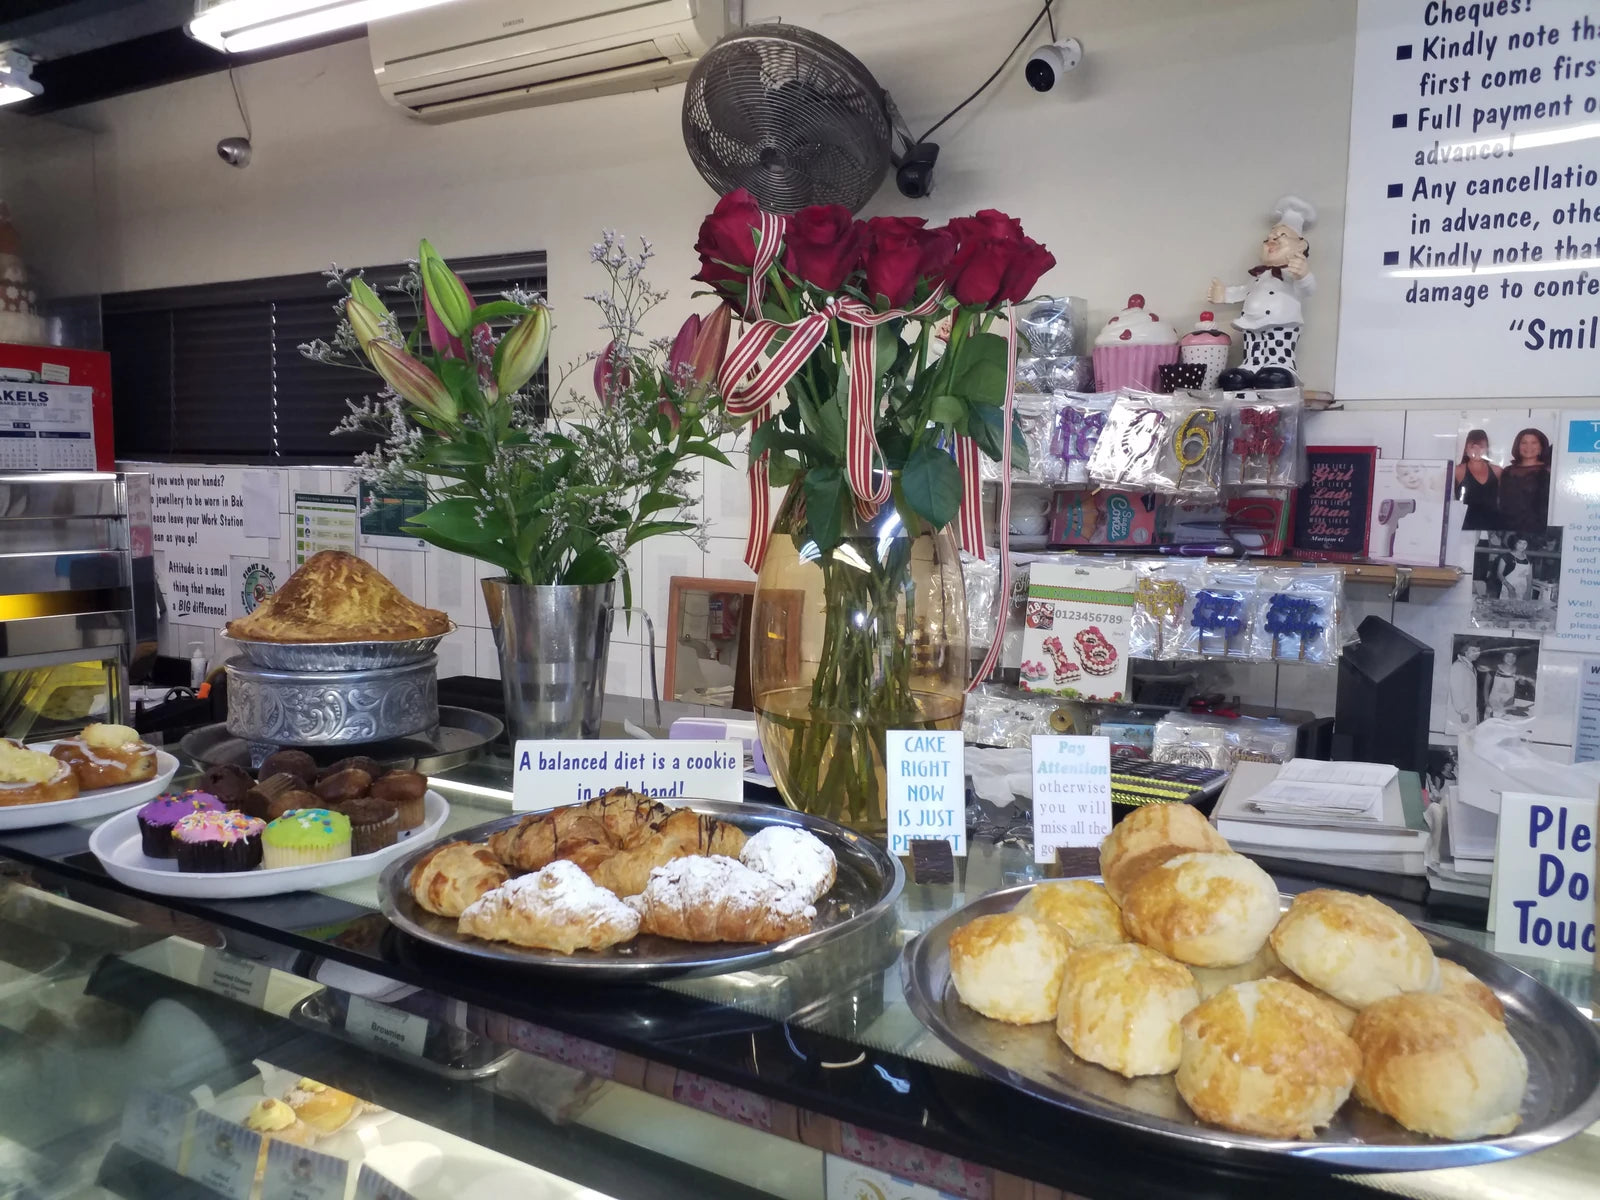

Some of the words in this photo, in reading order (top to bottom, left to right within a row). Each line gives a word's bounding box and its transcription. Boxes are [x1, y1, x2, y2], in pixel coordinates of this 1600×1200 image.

[1423, 30, 1498, 61] Kindly
[1508, 25, 1559, 50] note
[1572, 15, 1600, 42] th
[1420, 71, 1471, 96] first
[1482, 67, 1541, 89] come
[1554, 55, 1600, 80] firs
[1418, 103, 1461, 131] Full
[1473, 94, 1573, 133] payment
[1584, 97, 1600, 113] o
[1415, 132, 1515, 166] advance!
[1412, 176, 1456, 205] Any
[1466, 164, 1598, 196] cancellatio
[1411, 213, 1430, 235] in
[1441, 207, 1541, 233] advance,
[1553, 199, 1600, 225] othe
[1409, 242, 1483, 273] Kindly
[1493, 241, 1543, 264] note
[1406, 280, 1489, 308] damage
[1500, 278, 1523, 299] to
[1534, 271, 1600, 297] confe
[148, 473, 155, 485] d
[157, 477, 168, 488] you
[169, 474, 184, 486] wash
[186, 477, 200, 490] your
[202, 474, 225, 487] hands?
[156, 493, 184, 509] jewellery
[186, 495, 193, 506] to
[195, 494, 202, 506] be
[204, 498, 220, 507] worn
[222, 496, 229, 507] in
[231, 495, 244, 507] Bak
[153, 514, 166, 523] ease
[168, 512, 184, 524] leave
[186, 516, 200, 528] your
[201, 513, 218, 526] Work
[219, 514, 244, 527] Station
[154, 534, 164, 542] ean
[166, 534, 173, 542] as
[175, 535, 185, 546] you
[188, 532, 198, 547] go!
[168, 561, 195, 574] Attitude
[196, 564, 203, 574] is
[205, 566, 209, 575] a
[210, 564, 228, 577] small
[173, 580, 189, 596] thing
[191, 581, 204, 594] that
[206, 583, 225, 597] makes
[172, 602, 176, 611] a
[178, 600, 191, 613] BIG
[192, 601, 227, 616] difference!
[1055, 610, 1122, 624] 0123456789
[904, 736, 946, 752] CAKE
[1058, 741, 1086, 756] Pay
[519, 751, 531, 771] A
[538, 751, 607, 770] balanced
[614, 750, 645, 769] diet
[652, 752, 665, 769] is
[672, 756, 680, 769] a
[686, 750, 736, 769] cookie
[901, 760, 950, 777] RIGHT
[1037, 761, 1107, 775] Attention
[577, 783, 592, 800] in
[598, 781, 633, 798] eh
[641, 781, 684, 798] hand!
[907, 785, 944, 802] NOW
[1039, 780, 1106, 794] otherwise
[1039, 803, 1066, 816] you
[1078, 801, 1106, 814] will
[898, 809, 911, 827] IS
[916, 809, 955, 827] JUST
[1041, 821, 1067, 834] miss
[1070, 821, 1085, 835] all
[1088, 821, 1108, 835] the
[1529, 805, 1592, 852] Ple
[1041, 842, 1069, 857] go
[1538, 853, 1589, 901] Do
[1513, 900, 1596, 953] Touc
[370, 1021, 406, 1042] Brownies
